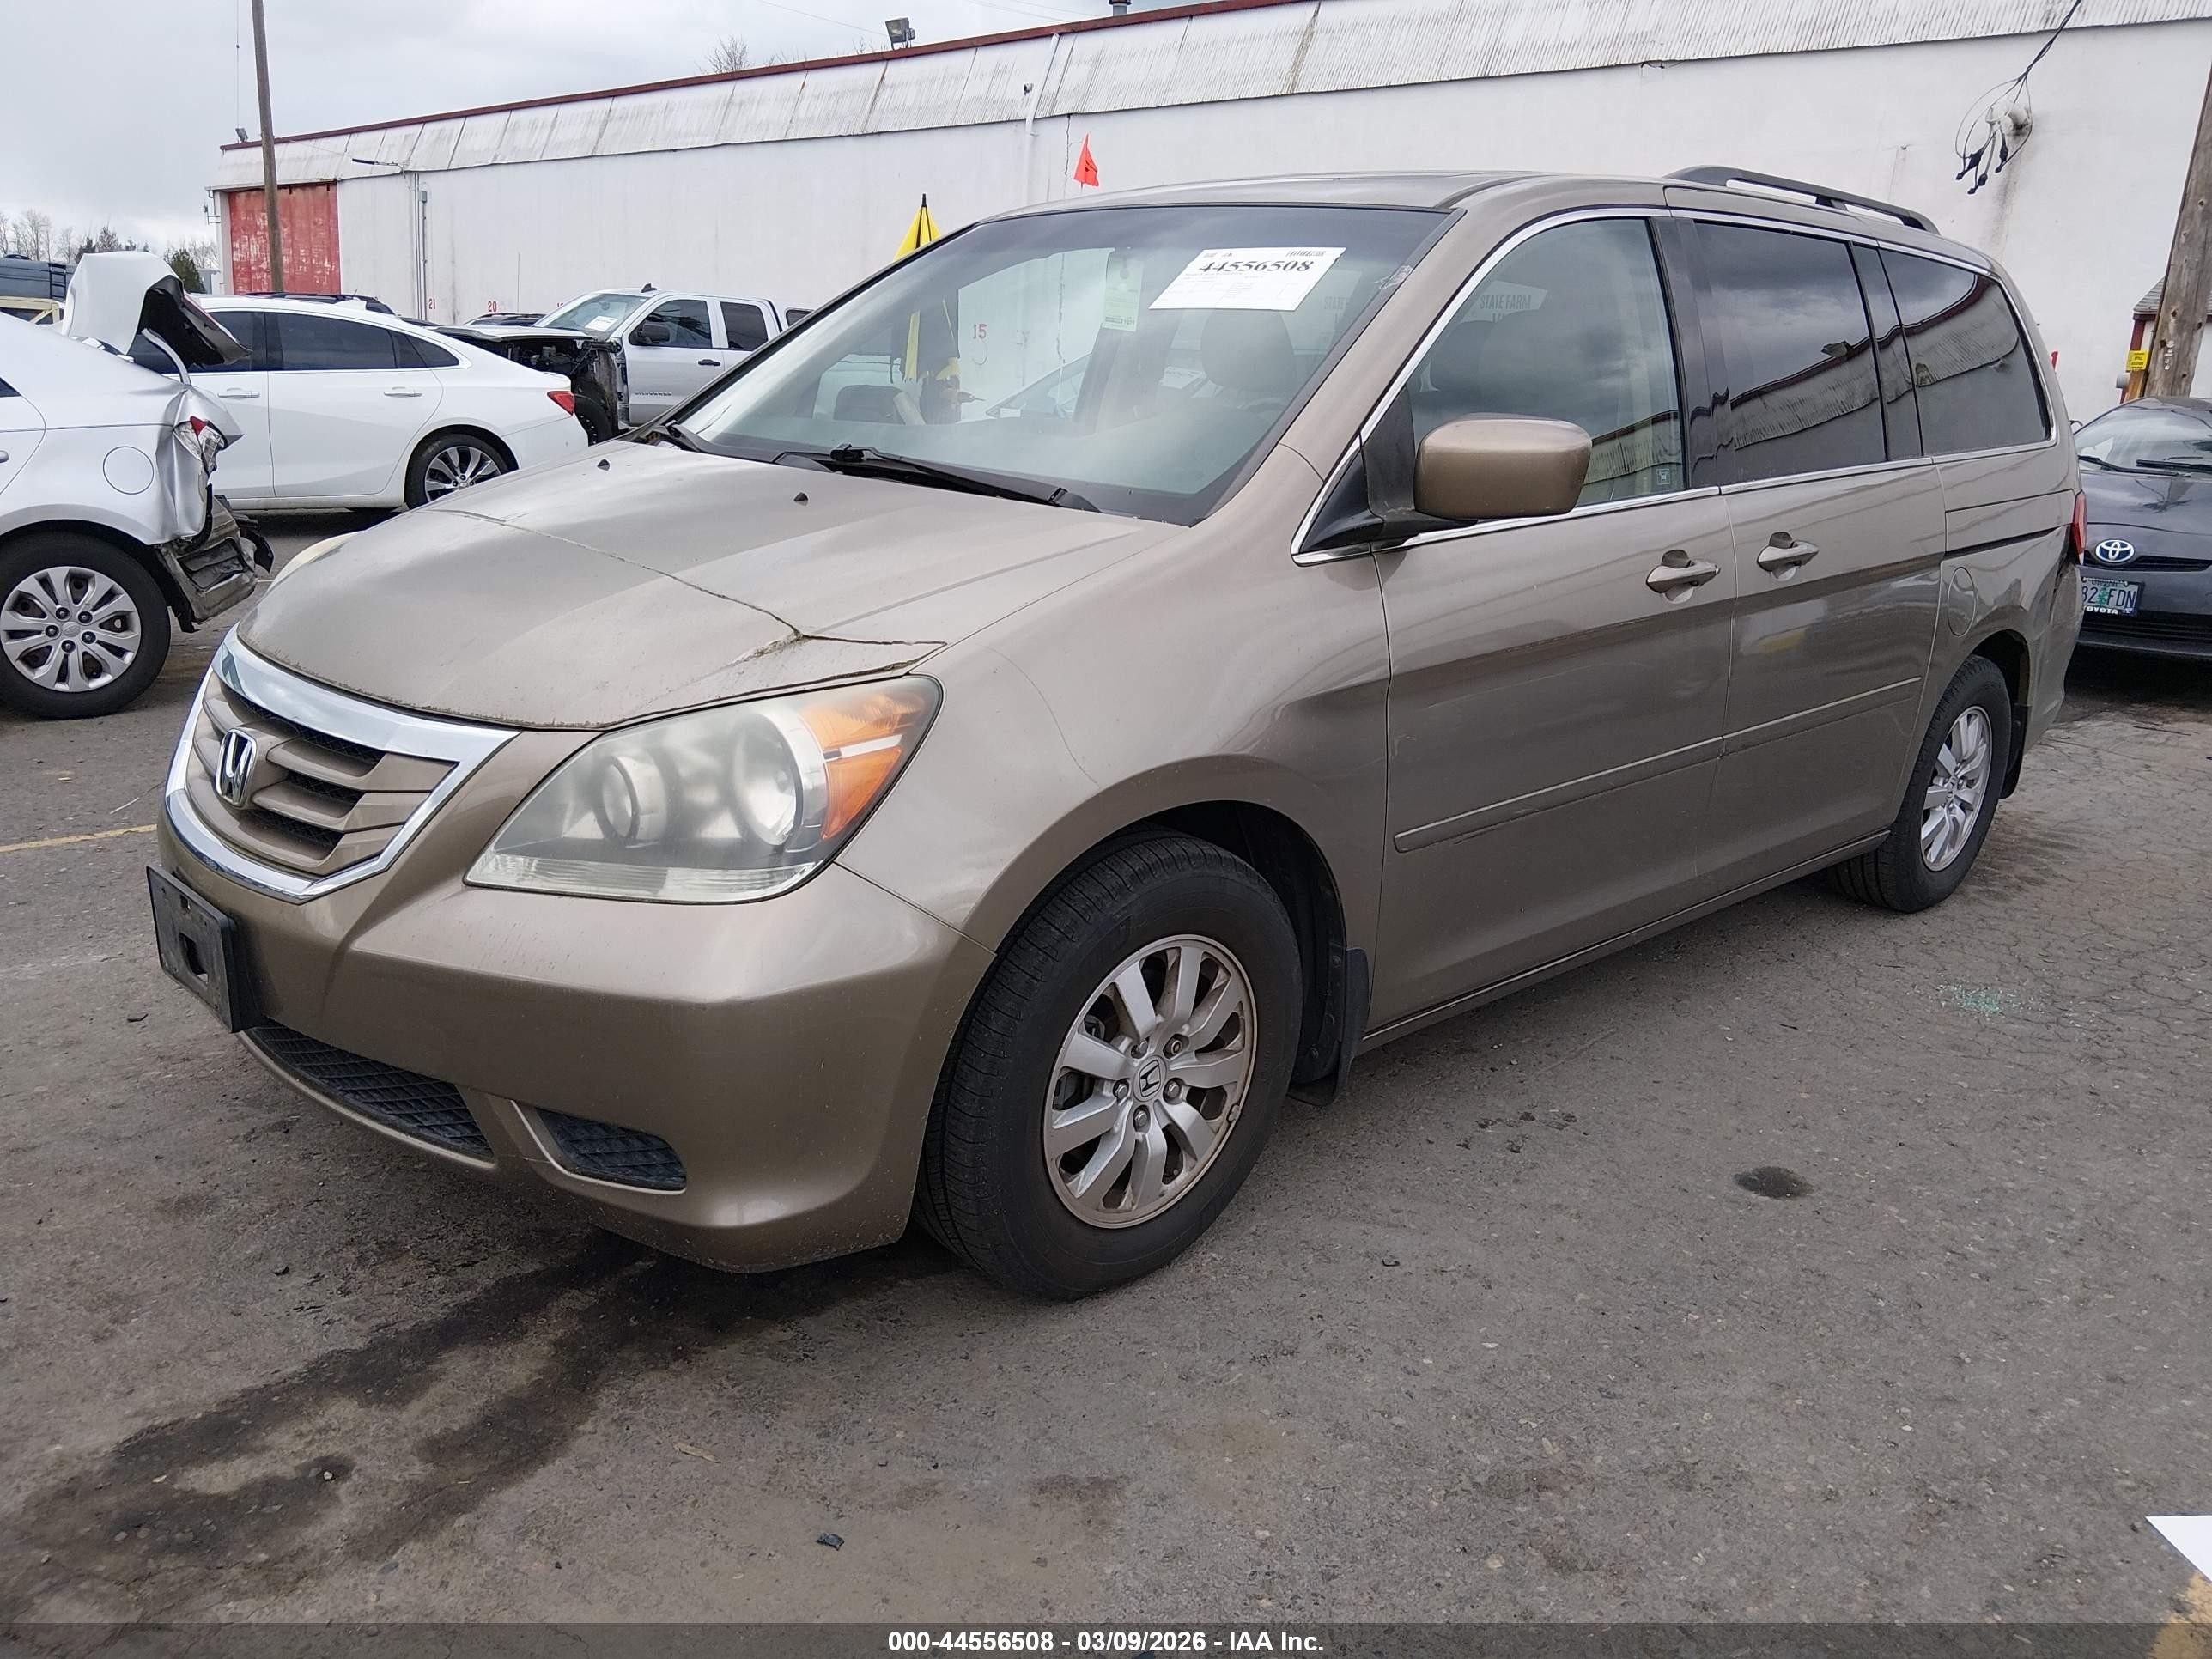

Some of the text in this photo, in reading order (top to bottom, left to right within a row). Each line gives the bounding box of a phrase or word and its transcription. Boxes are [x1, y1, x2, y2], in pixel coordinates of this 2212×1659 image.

[1199, 260, 1315, 272] 44556508
[428, 298, 436, 310] 21
[488, 301, 497, 313] 20
[1480, 295, 1504, 310] STATE
[973, 323, 988, 339] 15
[2106, 588, 2136, 608] FDN
